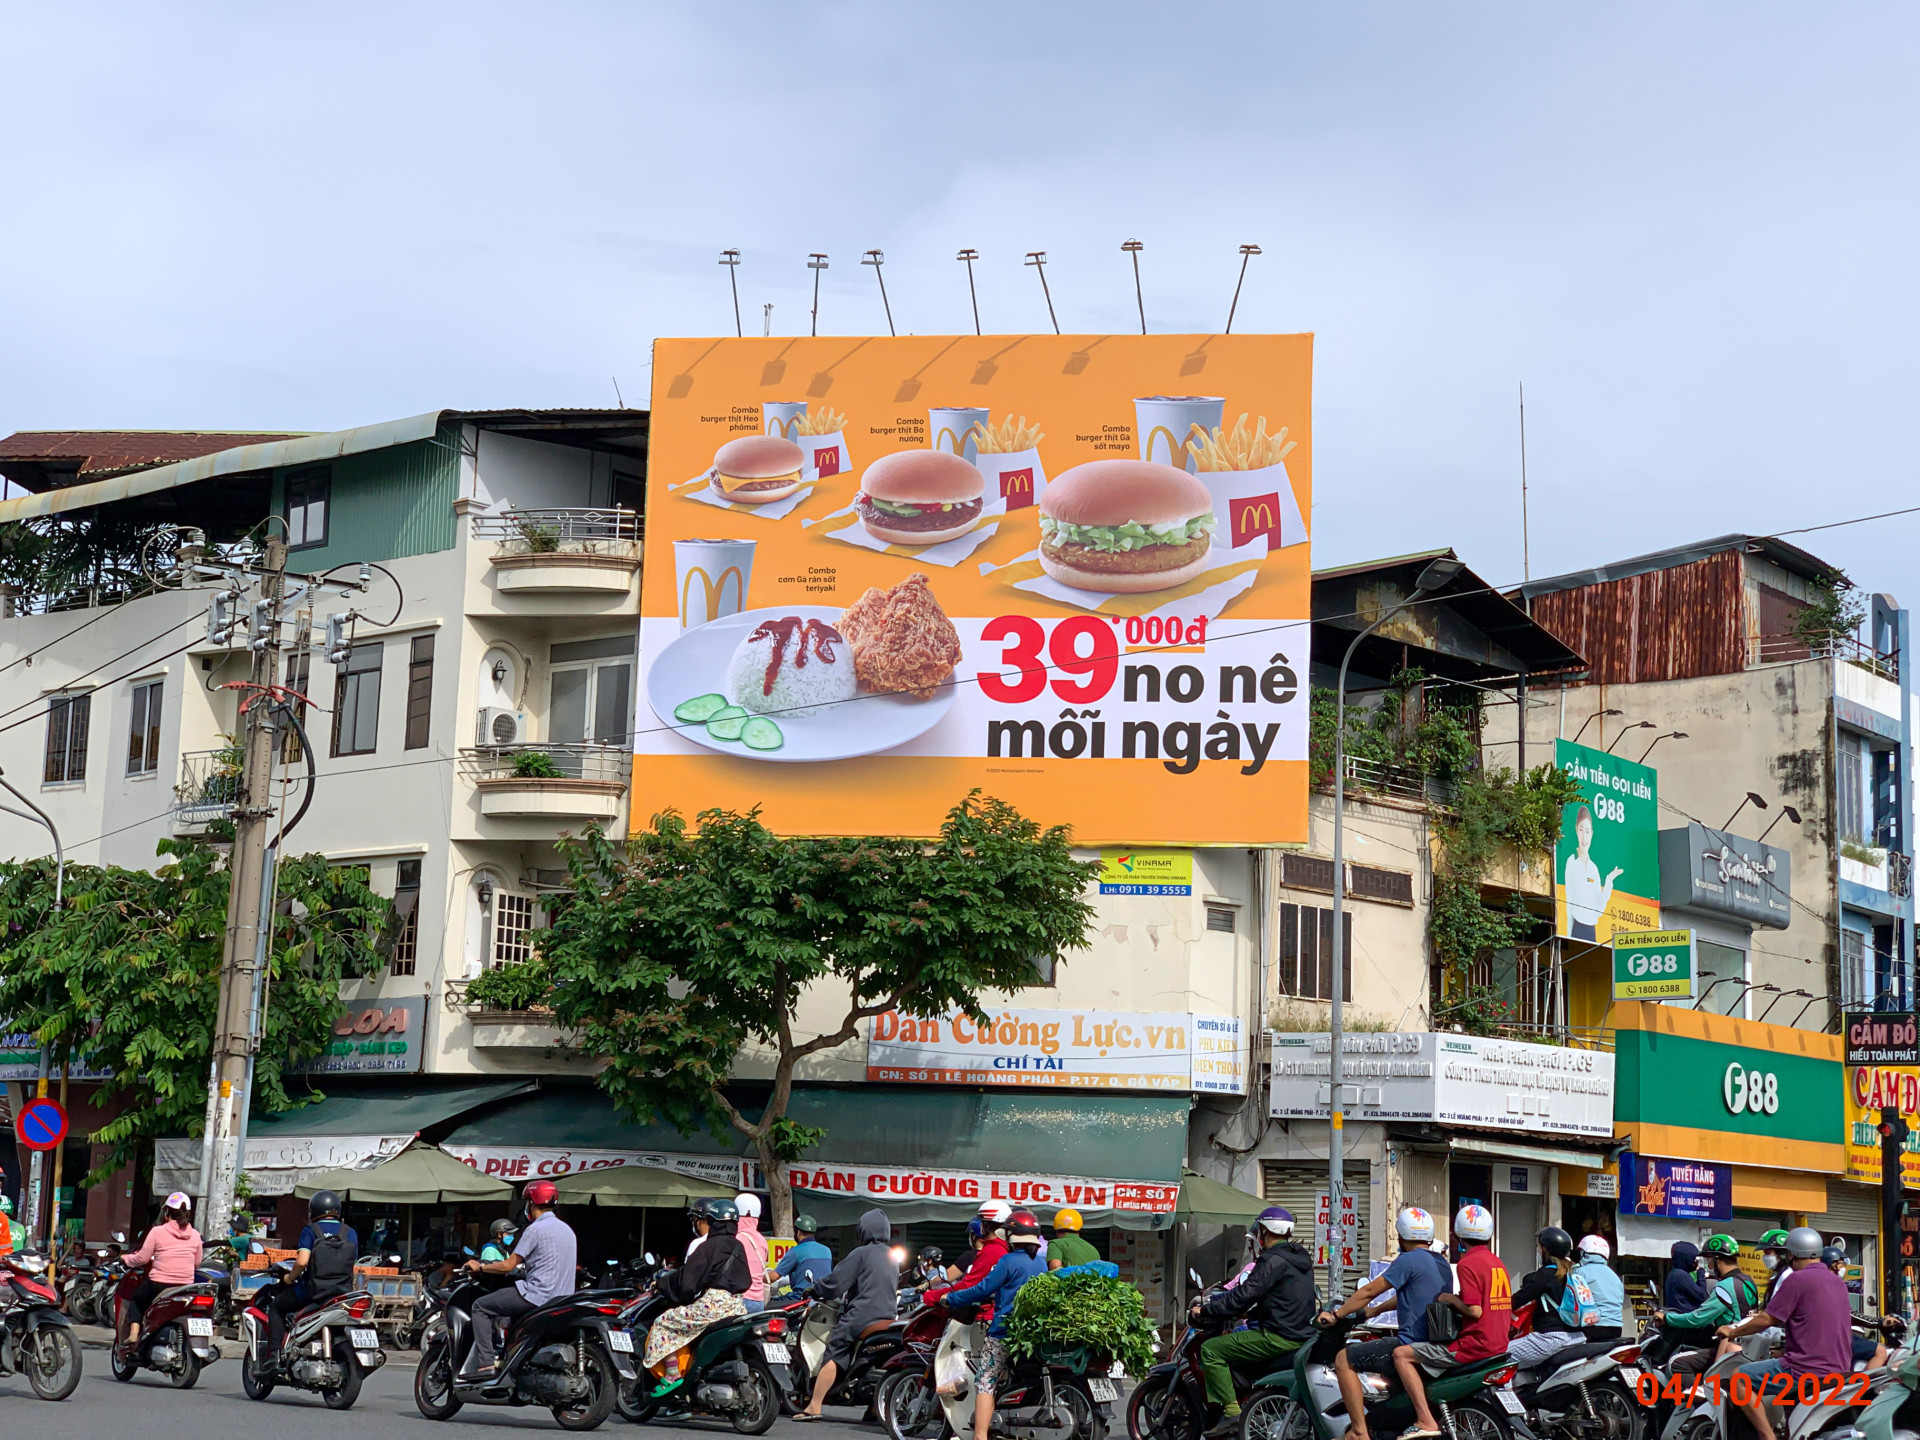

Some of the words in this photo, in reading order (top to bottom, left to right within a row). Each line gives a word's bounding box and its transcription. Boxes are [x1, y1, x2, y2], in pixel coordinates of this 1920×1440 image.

[731, 406, 759, 414] Combo
[700, 415, 727, 424] burger
[728, 415, 742, 424] thịt
[743, 415, 759, 423] Heo
[896, 417, 925, 425] Combo
[870, 427, 896, 435] burger
[898, 427, 912, 435] thịt
[1076, 434, 1102, 442] burger
[1104, 434, 1119, 442] thịt
[1102, 425, 1131, 433] Combo
[1094, 442, 1107, 450] sốt
[1108, 443, 1131, 451] mayo
[805, 584, 836, 593] teriyaki
[1123, 664, 1205, 704] no
[1218, 652, 1298, 704] nê
[987, 708, 1105, 759] mỗi
[1122, 709, 1281, 776] ngày
[1565, 757, 1588, 781] CẦN
[1589, 764, 1610, 788] TIỀN
[1611, 776, 1631, 797] GỌI
[1632, 777, 1652, 801] LIỀN
[1593, 792, 1625, 824] F88
[1104, 886, 1118, 894] LH:
[1118, 885, 1143, 894] 0911
[1146, 886, 1160, 894] 39
[1161, 886, 1187, 895] 5555
[1618, 909, 1634, 922] 1800
[1635, 914, 1651, 928] 6388
[1618, 935, 1636, 945] CẦN
[1637, 933, 1652, 944] TIỀN
[1654, 935, 1669, 945] GỌI
[1671, 932, 1687, 942] LIỀN
[1627, 953, 1678, 977] F88
[1638, 985, 1658, 994] 1800
[1660, 984, 1680, 993] 6388
[334, 1008, 408, 1036] LOA
[1226, 1023, 1231, 1032] &
[1850, 1015, 1888, 1045] CẦM
[1892, 1014, 1917, 1045] ĐỒ
[1071, 1014, 1186, 1057] Lực.vn
[993, 1055, 1029, 1069] CHÍ
[1033, 1055, 1063, 1070] TÀI
[1445, 1041, 1472, 1051] HEINEKEN
[1563, 1051, 1594, 1072] P.69
[1849, 1047, 1870, 1061] HIẾU
[1870, 1048, 1894, 1061] TOÀN
[1894, 1048, 1917, 1061] PHÁT
[879, 1070, 904, 1080] CN:
[908, 1068, 928, 1081] SỐ
[933, 1072, 939, 1081] 1
[945, 1071, 962, 1082] LÊ
[966, 1072, 1017, 1083] HOÀNG
[1151, 1075, 1181, 1088] VẤP
[1216, 1060, 1242, 1079] THOẠI
[1724, 1061, 1779, 1114] F88
[1852, 1112, 1877, 1146] HIẾU
[484, 1154, 531, 1177] PHÊ
[537, 1151, 572, 1176] CỔ
[1671, 1165, 1693, 1182] TUYẾT
[789, 1167, 856, 1192] DÁN
[867, 1171, 979, 1198] CƯỜNG
[991, 1180, 1107, 1206] LỰC.VN
[1116, 1187, 1141, 1198] CN:
[1145, 1187, 1165, 1200] SỐ
[1169, 1191, 1176, 1200] 1
